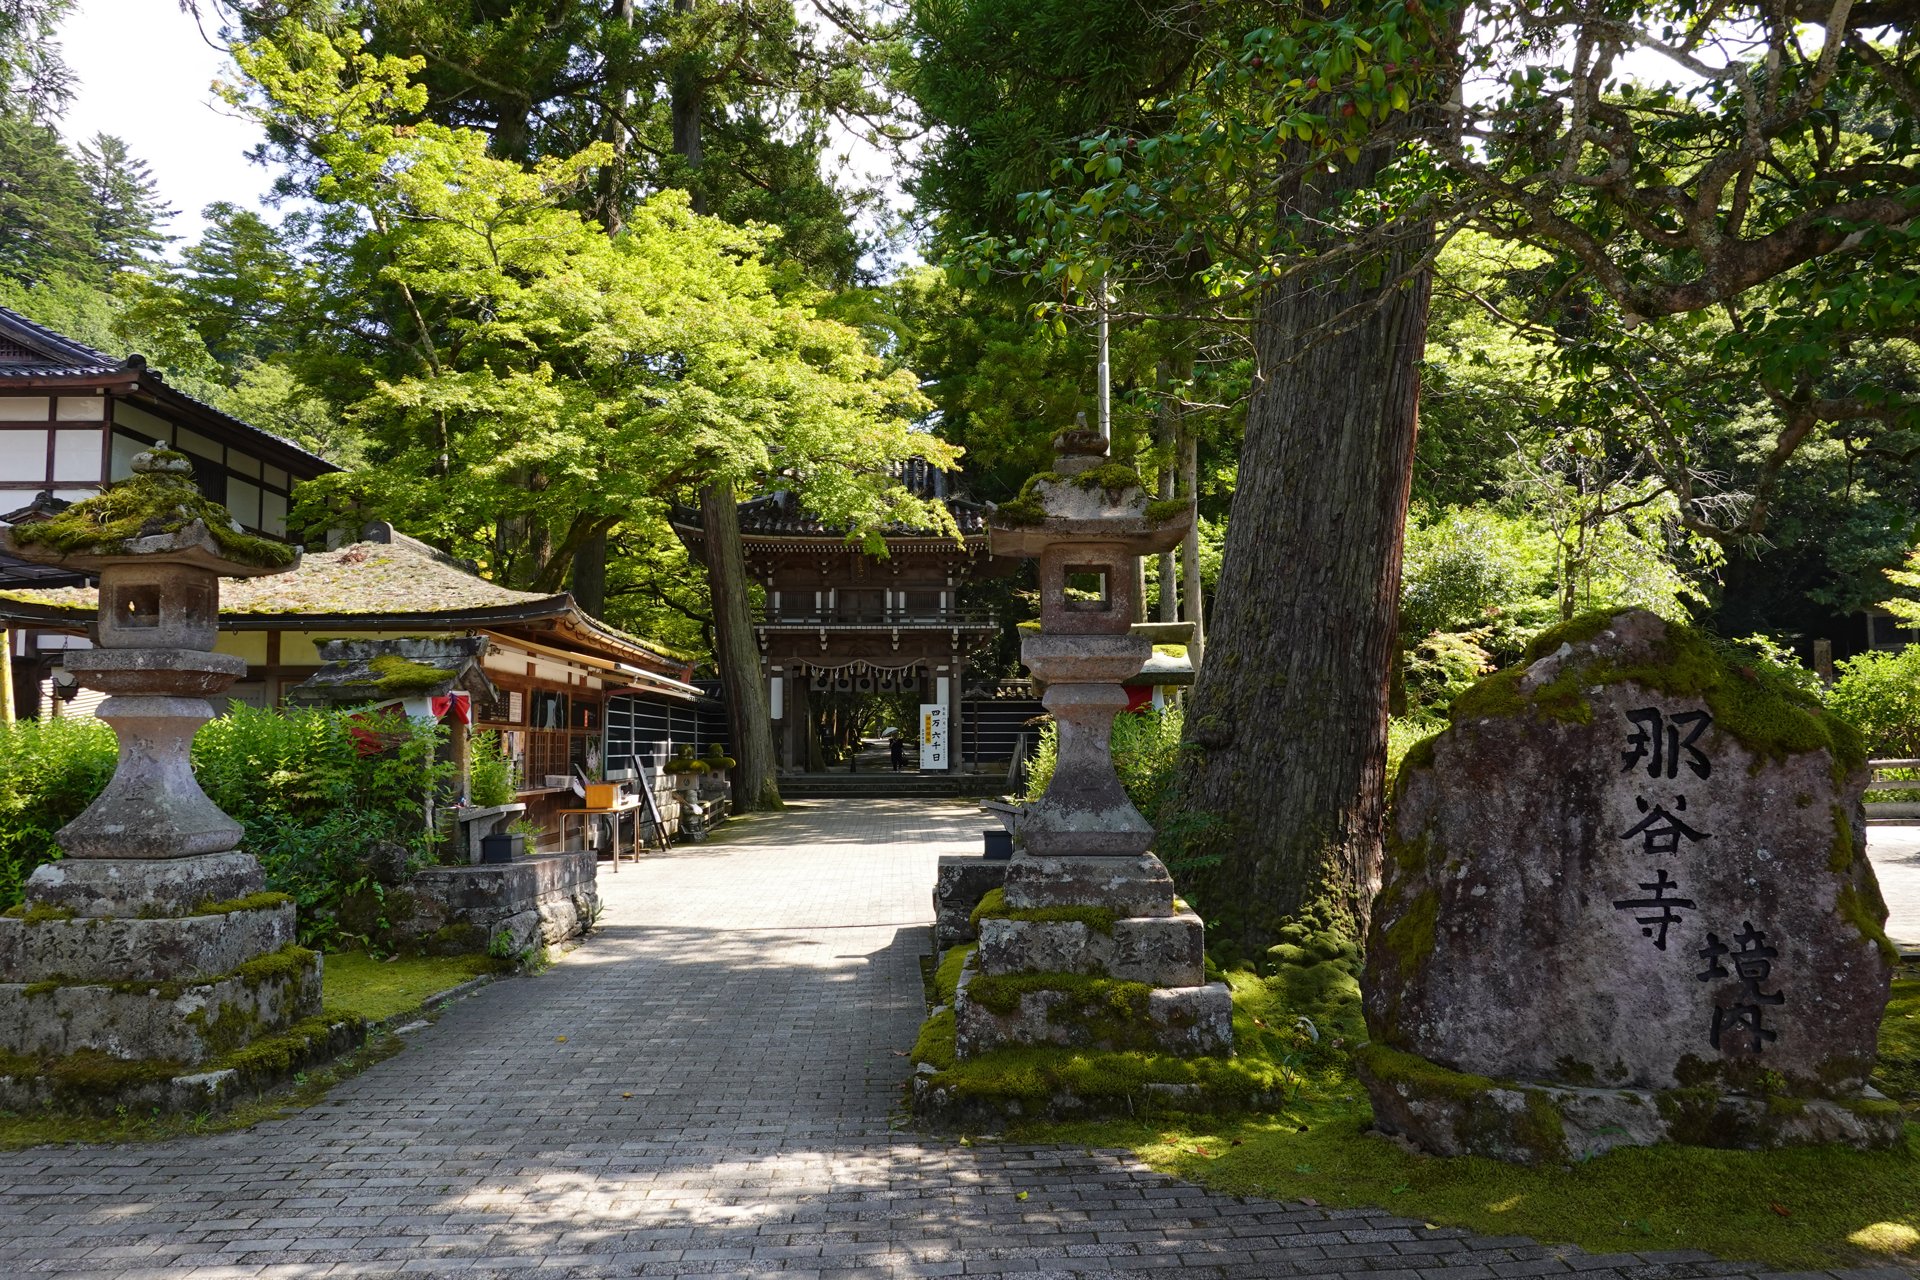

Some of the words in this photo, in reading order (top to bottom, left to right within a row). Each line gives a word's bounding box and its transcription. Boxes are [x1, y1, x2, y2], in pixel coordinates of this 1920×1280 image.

[931, 709, 941, 761] 四万六千日
[1613, 706, 1714, 951] 那谷寺
[1696, 921, 1785, 1053] 境内
